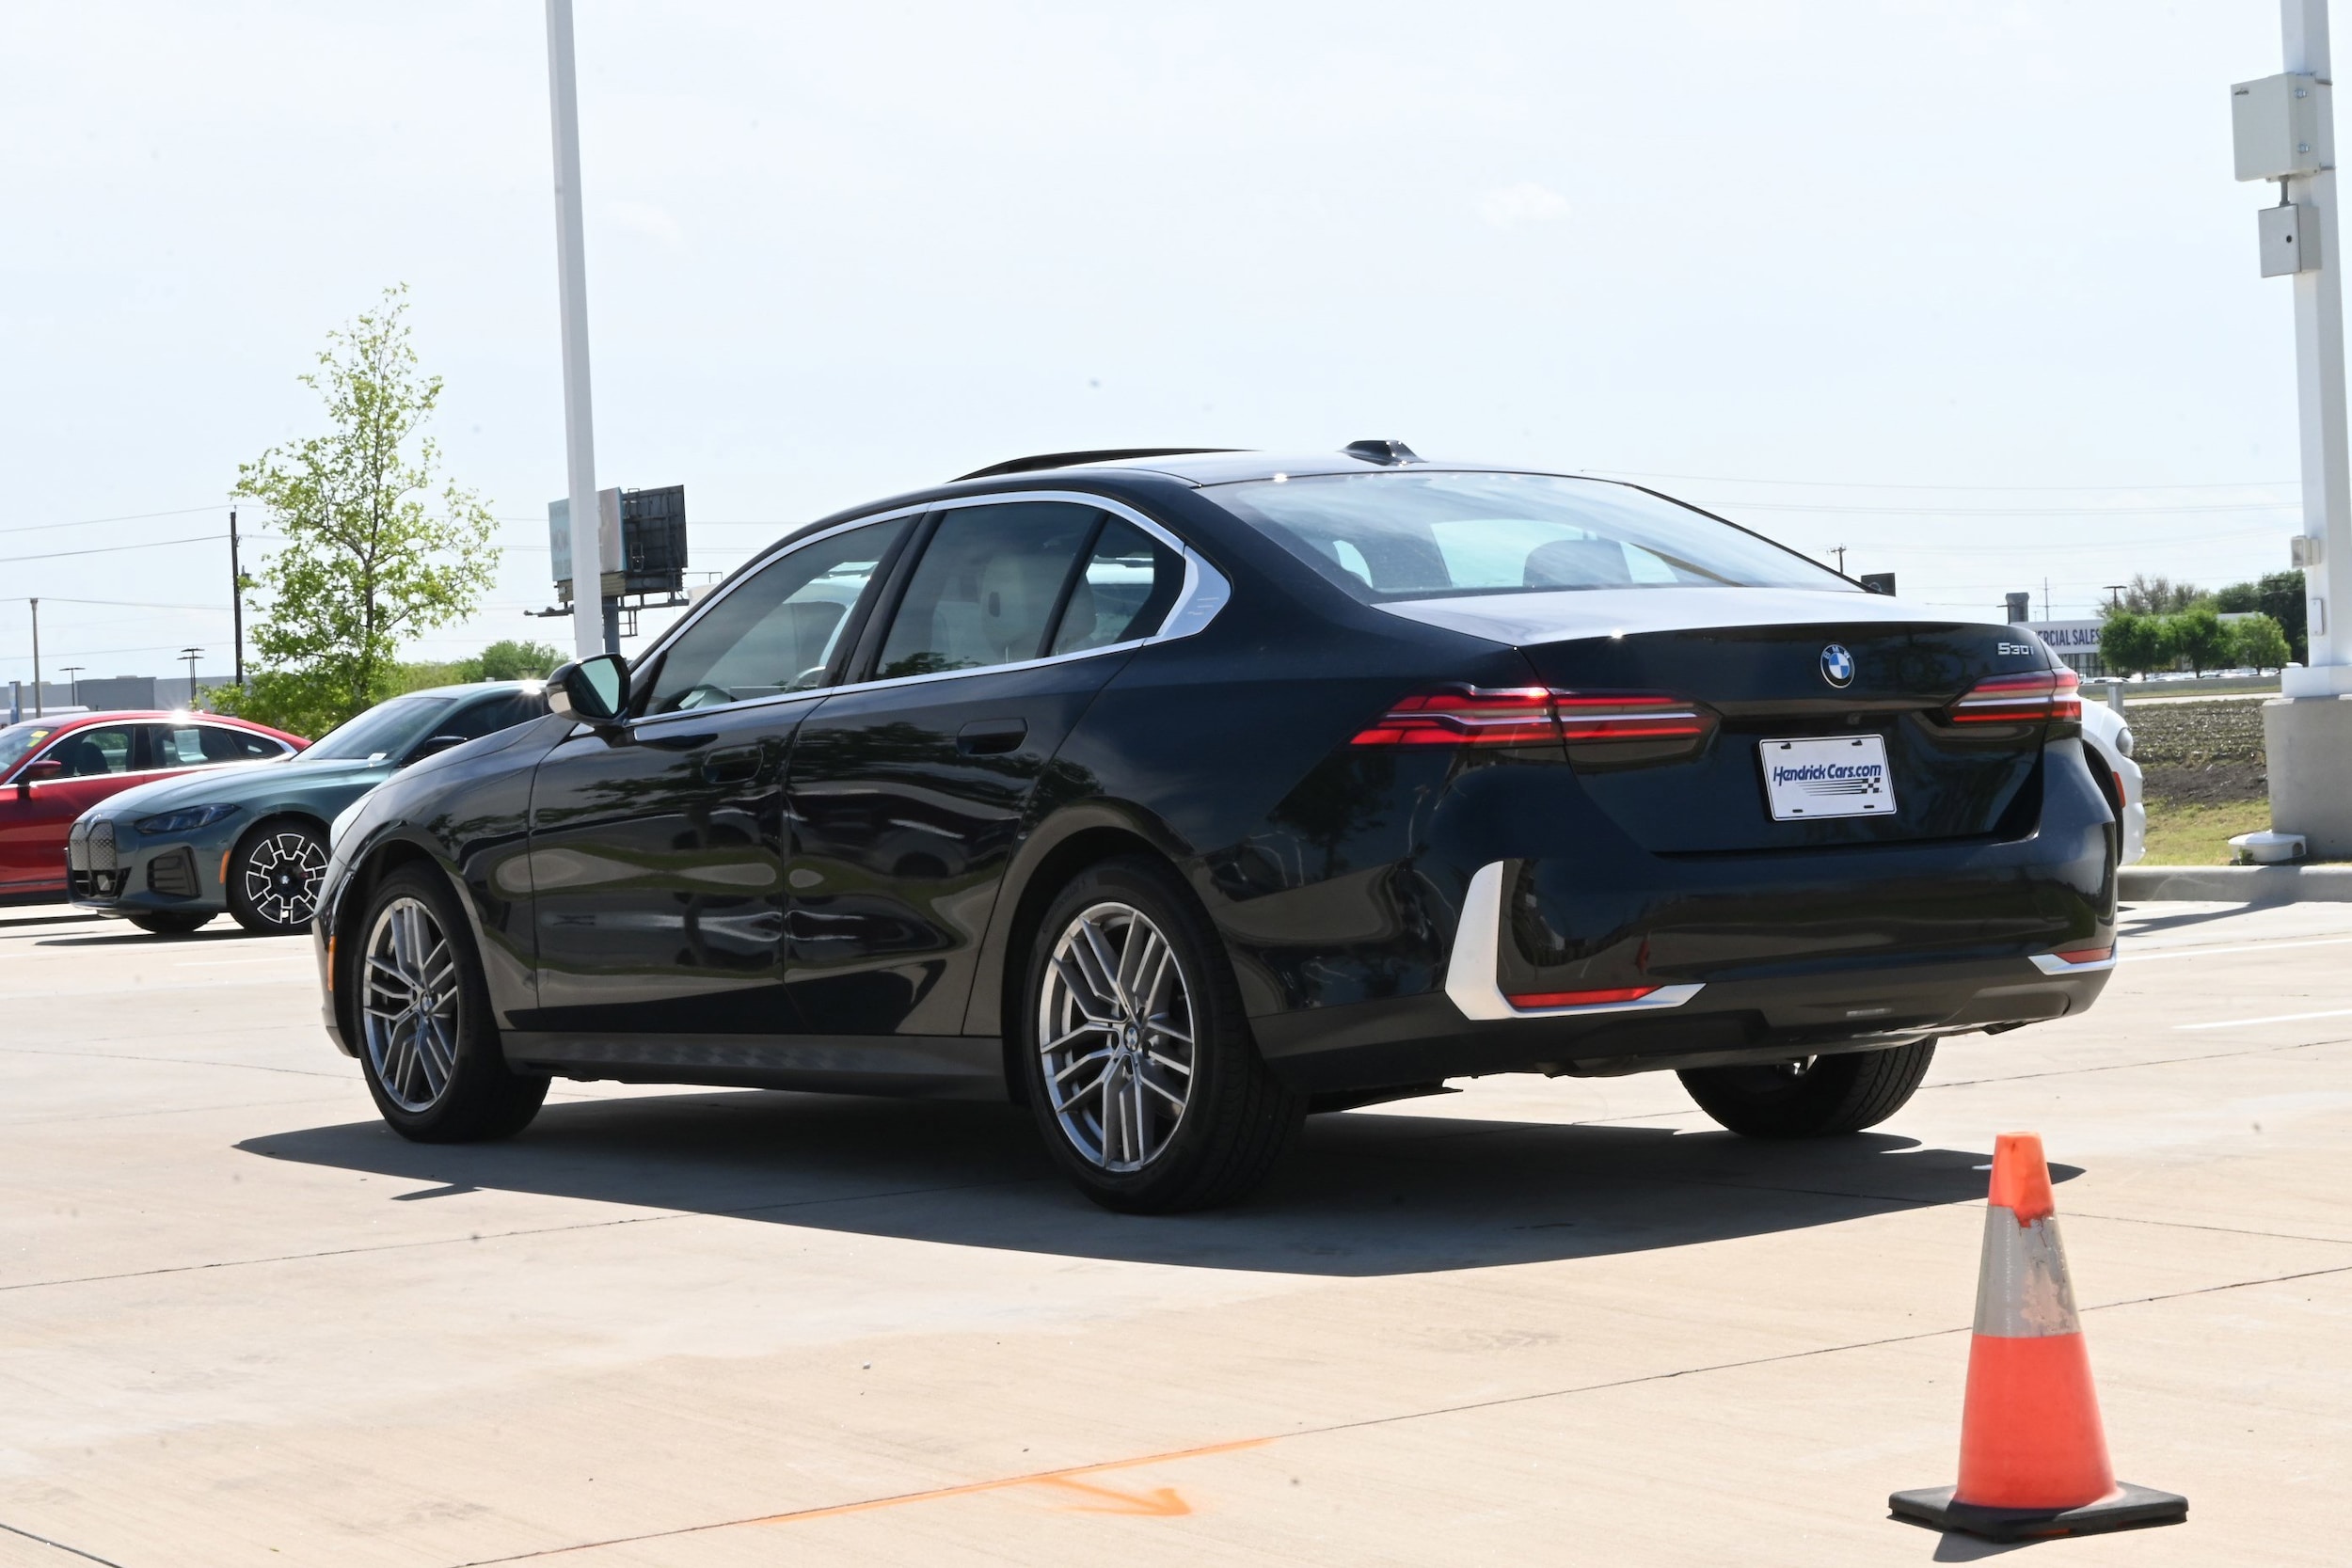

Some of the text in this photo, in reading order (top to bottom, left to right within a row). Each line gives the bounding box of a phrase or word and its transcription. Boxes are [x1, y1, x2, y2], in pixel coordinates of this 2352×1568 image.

[2035, 628, 2102, 646] RCIAL SALES
[1823, 645, 1851, 659] BMW
[1997, 642, 2034, 656] 530i
